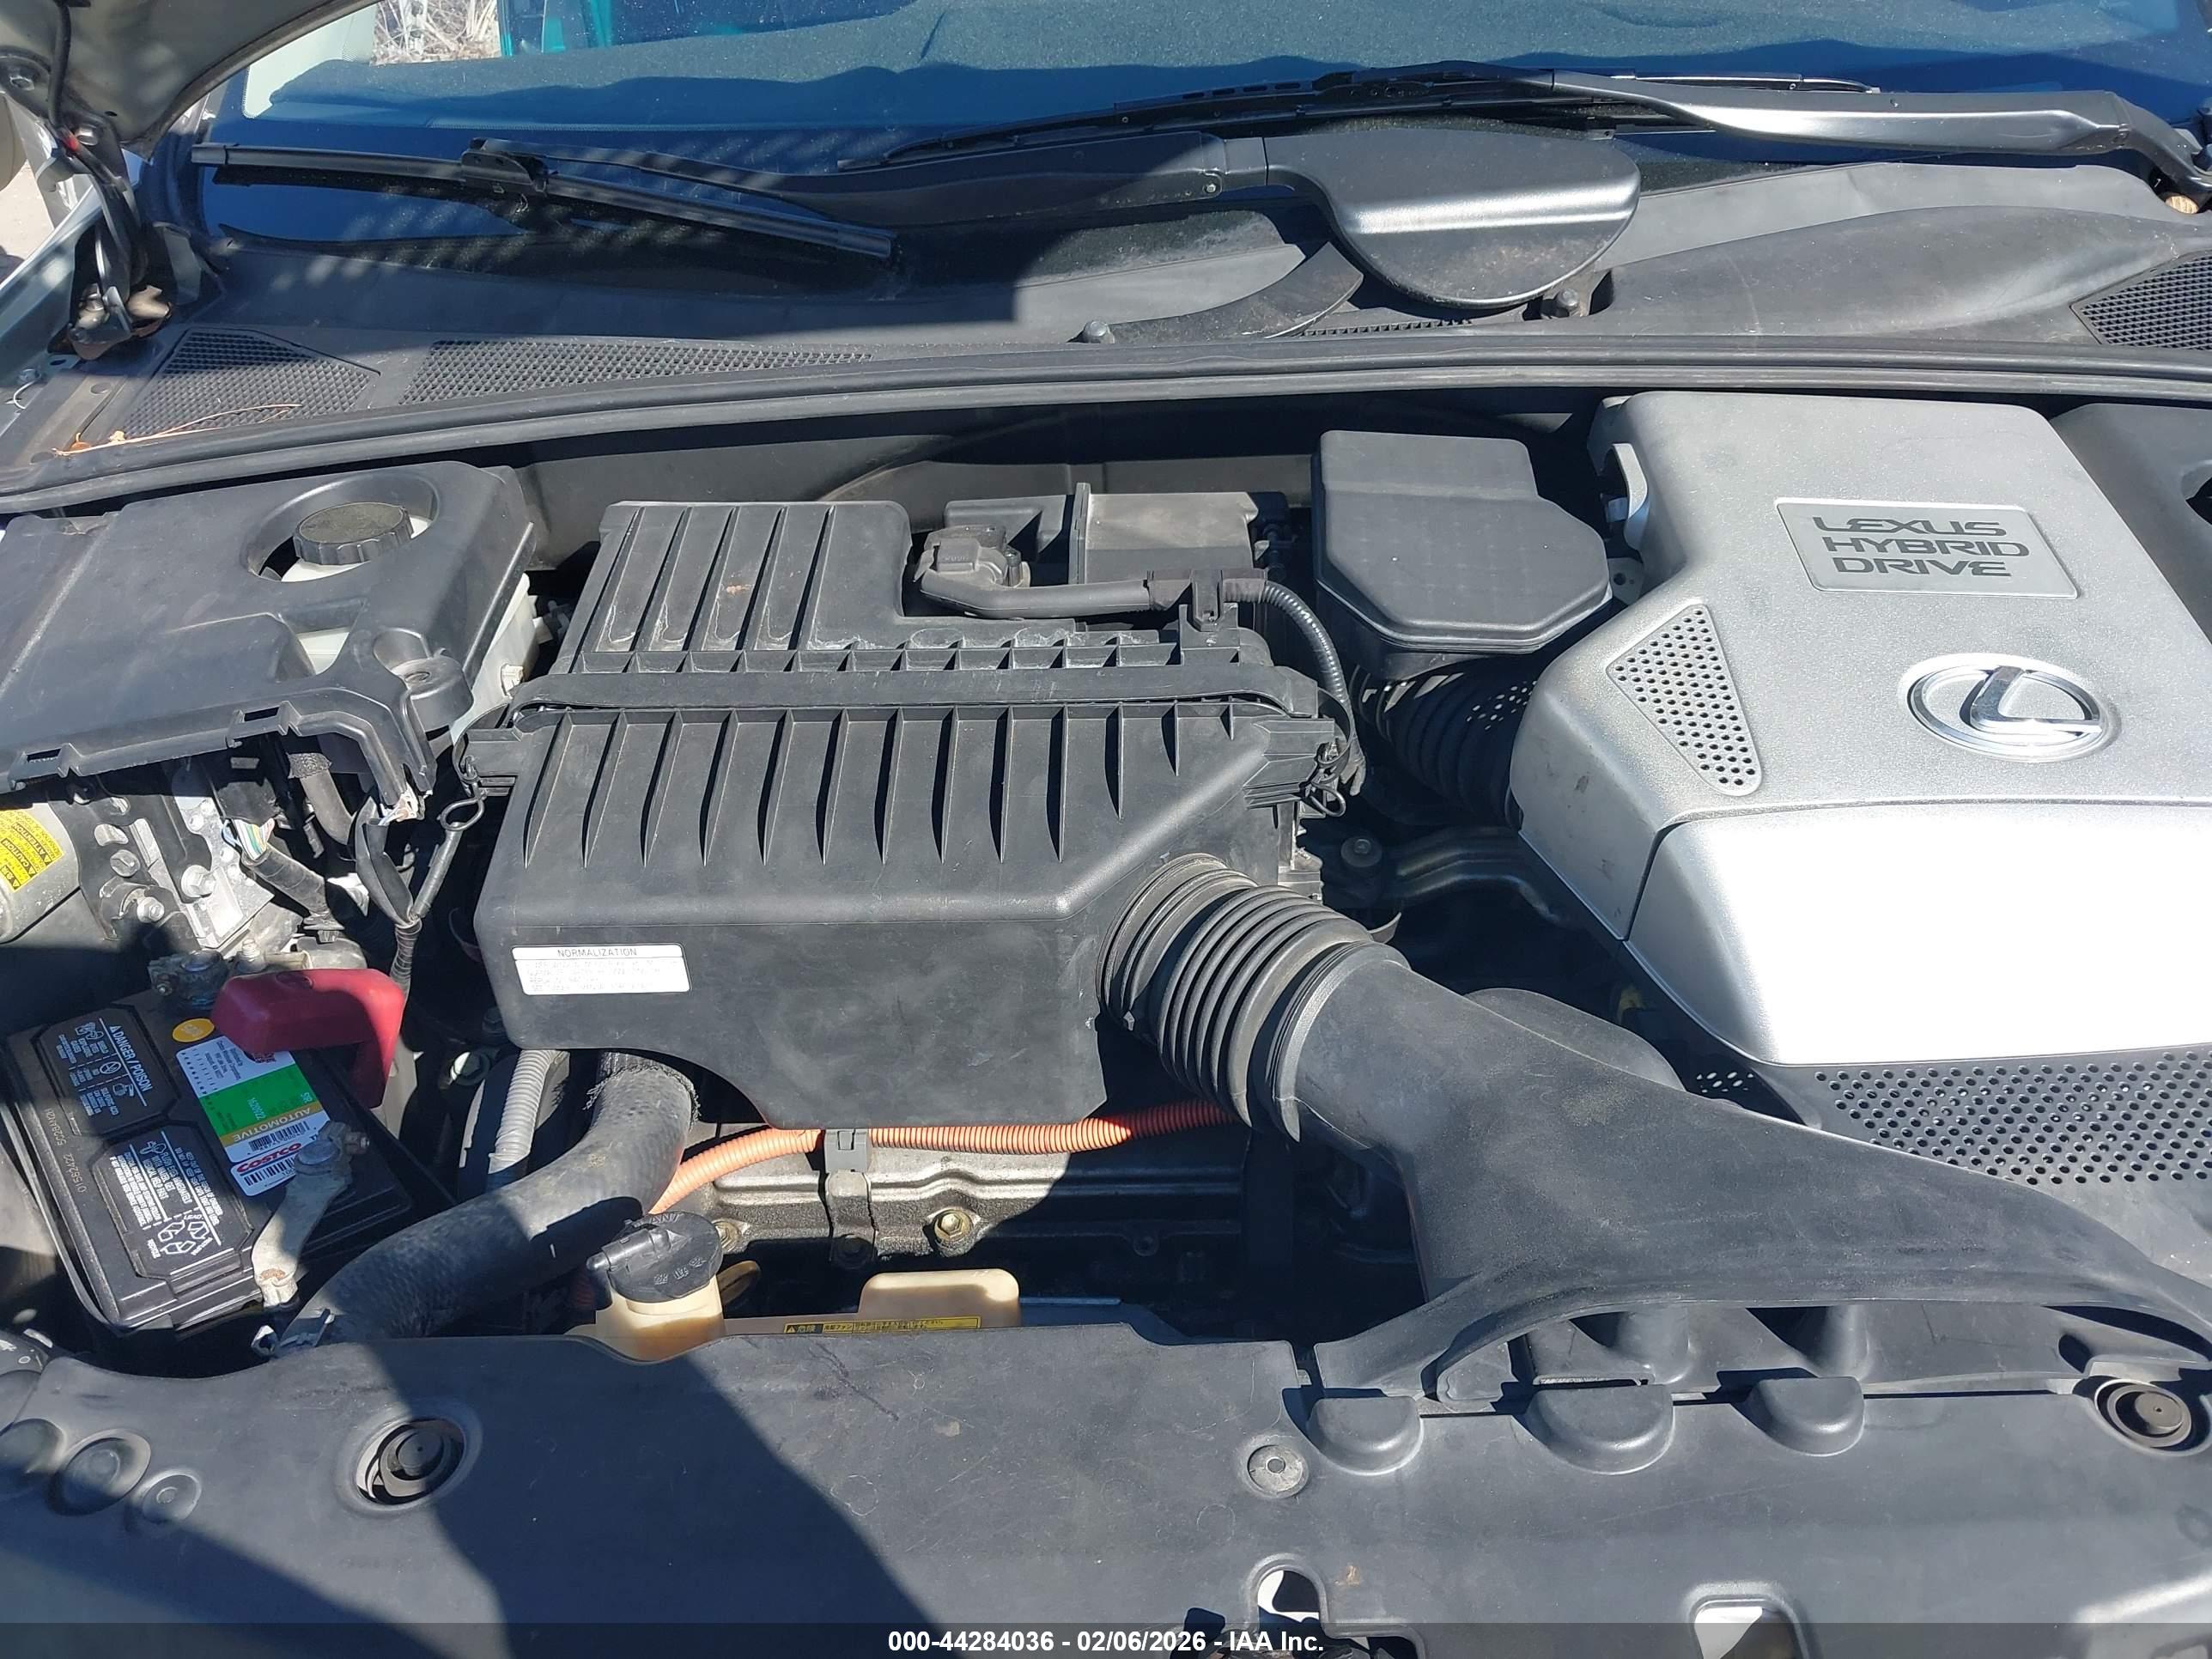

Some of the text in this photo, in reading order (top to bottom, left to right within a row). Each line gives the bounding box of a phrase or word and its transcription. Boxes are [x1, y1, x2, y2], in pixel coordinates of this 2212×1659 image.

[1813, 517, 2006, 537] LEXUS
[1821, 537, 2030, 556] HYBRID
[1832, 556, 2012, 577] DRIVE
[2, 838, 29, 867] CAUTION
[12, 822, 46, 855] ATTENTION
[557, 948, 637, 957] NORMALIZATION
[112, 1030, 136, 1060] DANGER
[130, 1064, 152, 1091] POISON
[232, 1106, 310, 1142] AUTOMOTIVE
[234, 1140, 302, 1175] COSTCO
